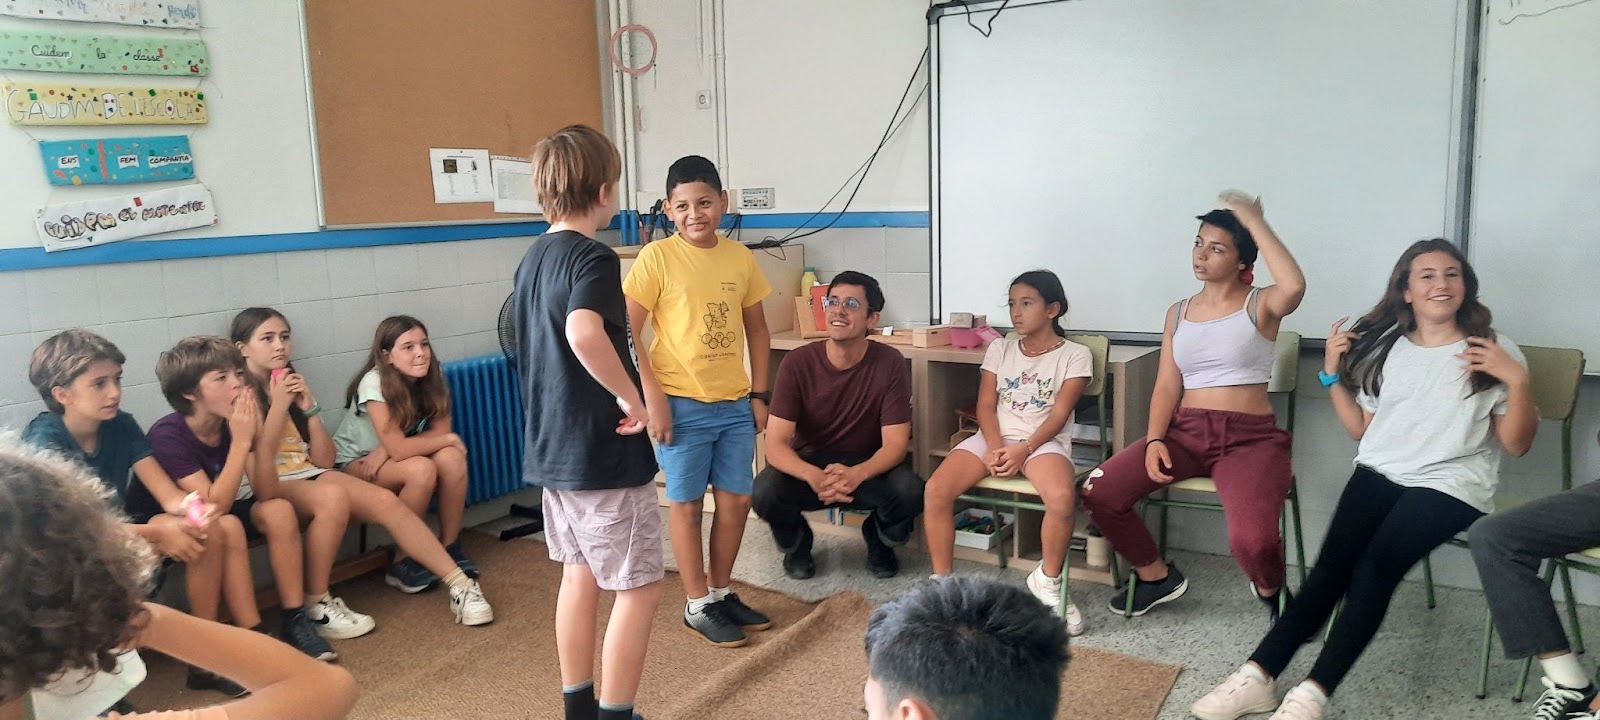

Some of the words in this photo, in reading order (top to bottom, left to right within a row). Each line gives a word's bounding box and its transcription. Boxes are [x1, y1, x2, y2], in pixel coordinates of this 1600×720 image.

[31, 45, 70, 58] Cuidem
[96, 48, 106, 59] la
[133, 49, 161, 61] classe
[102, 93, 127, 119] DE
